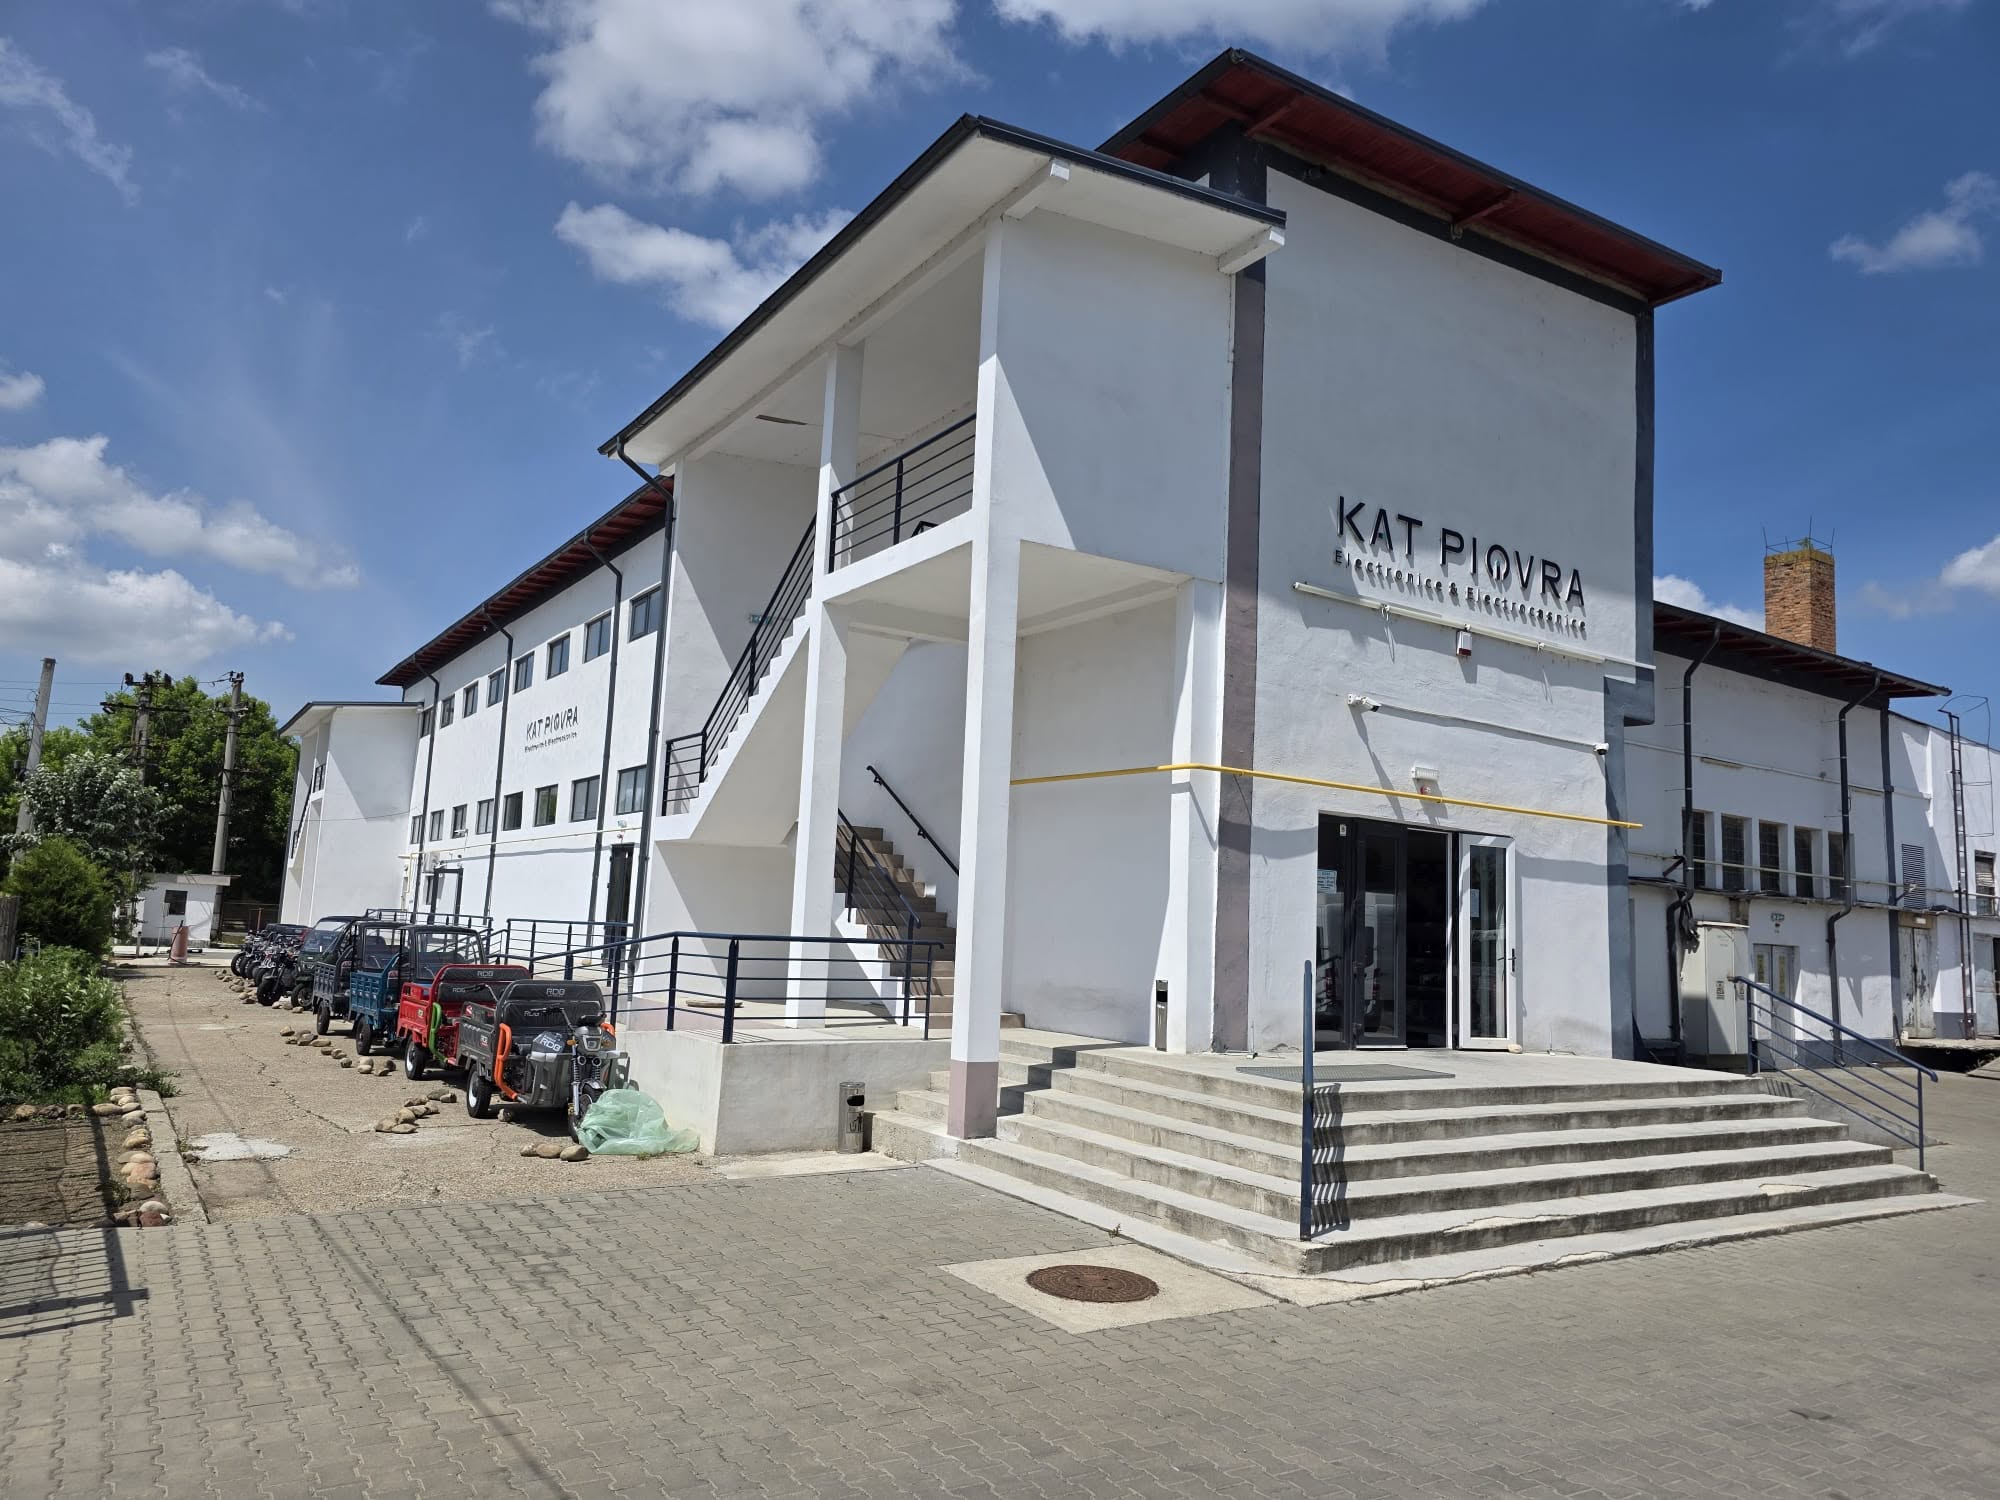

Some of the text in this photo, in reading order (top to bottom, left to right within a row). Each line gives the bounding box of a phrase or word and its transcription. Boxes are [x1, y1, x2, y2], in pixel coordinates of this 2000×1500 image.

[1337, 495, 1585, 607] KAT PIOVRA
[1334, 549, 1586, 630] Electronice & Electrocasnice
[527, 705, 578, 741] KAT PIOVRA
[539, 1038, 561, 1052] RDB
